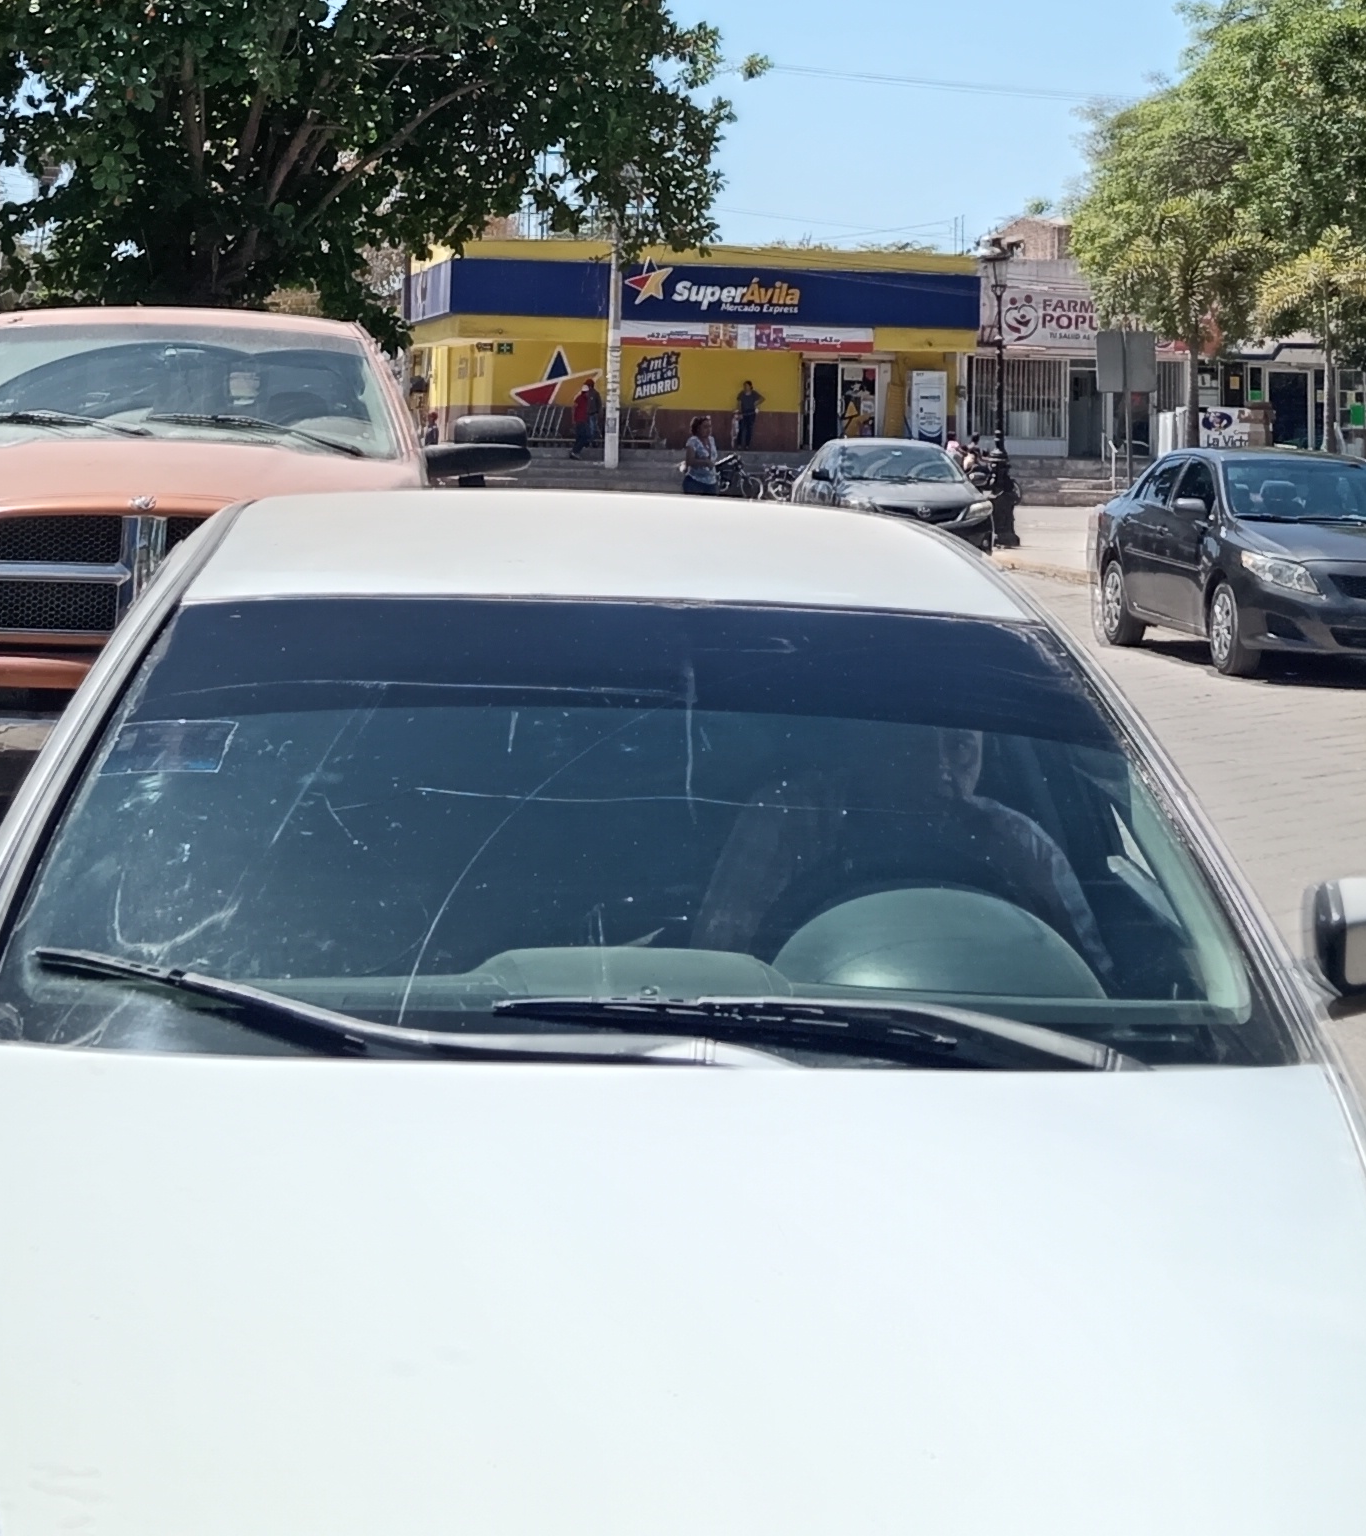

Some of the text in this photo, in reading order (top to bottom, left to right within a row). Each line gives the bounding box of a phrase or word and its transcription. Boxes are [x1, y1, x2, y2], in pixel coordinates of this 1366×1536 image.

[671, 277, 801, 311] SuperÁvila
[720, 303, 799, 314] Mercado Express
[1042, 298, 1099, 313] FARM
[634, 378, 679, 399] AHORRO
